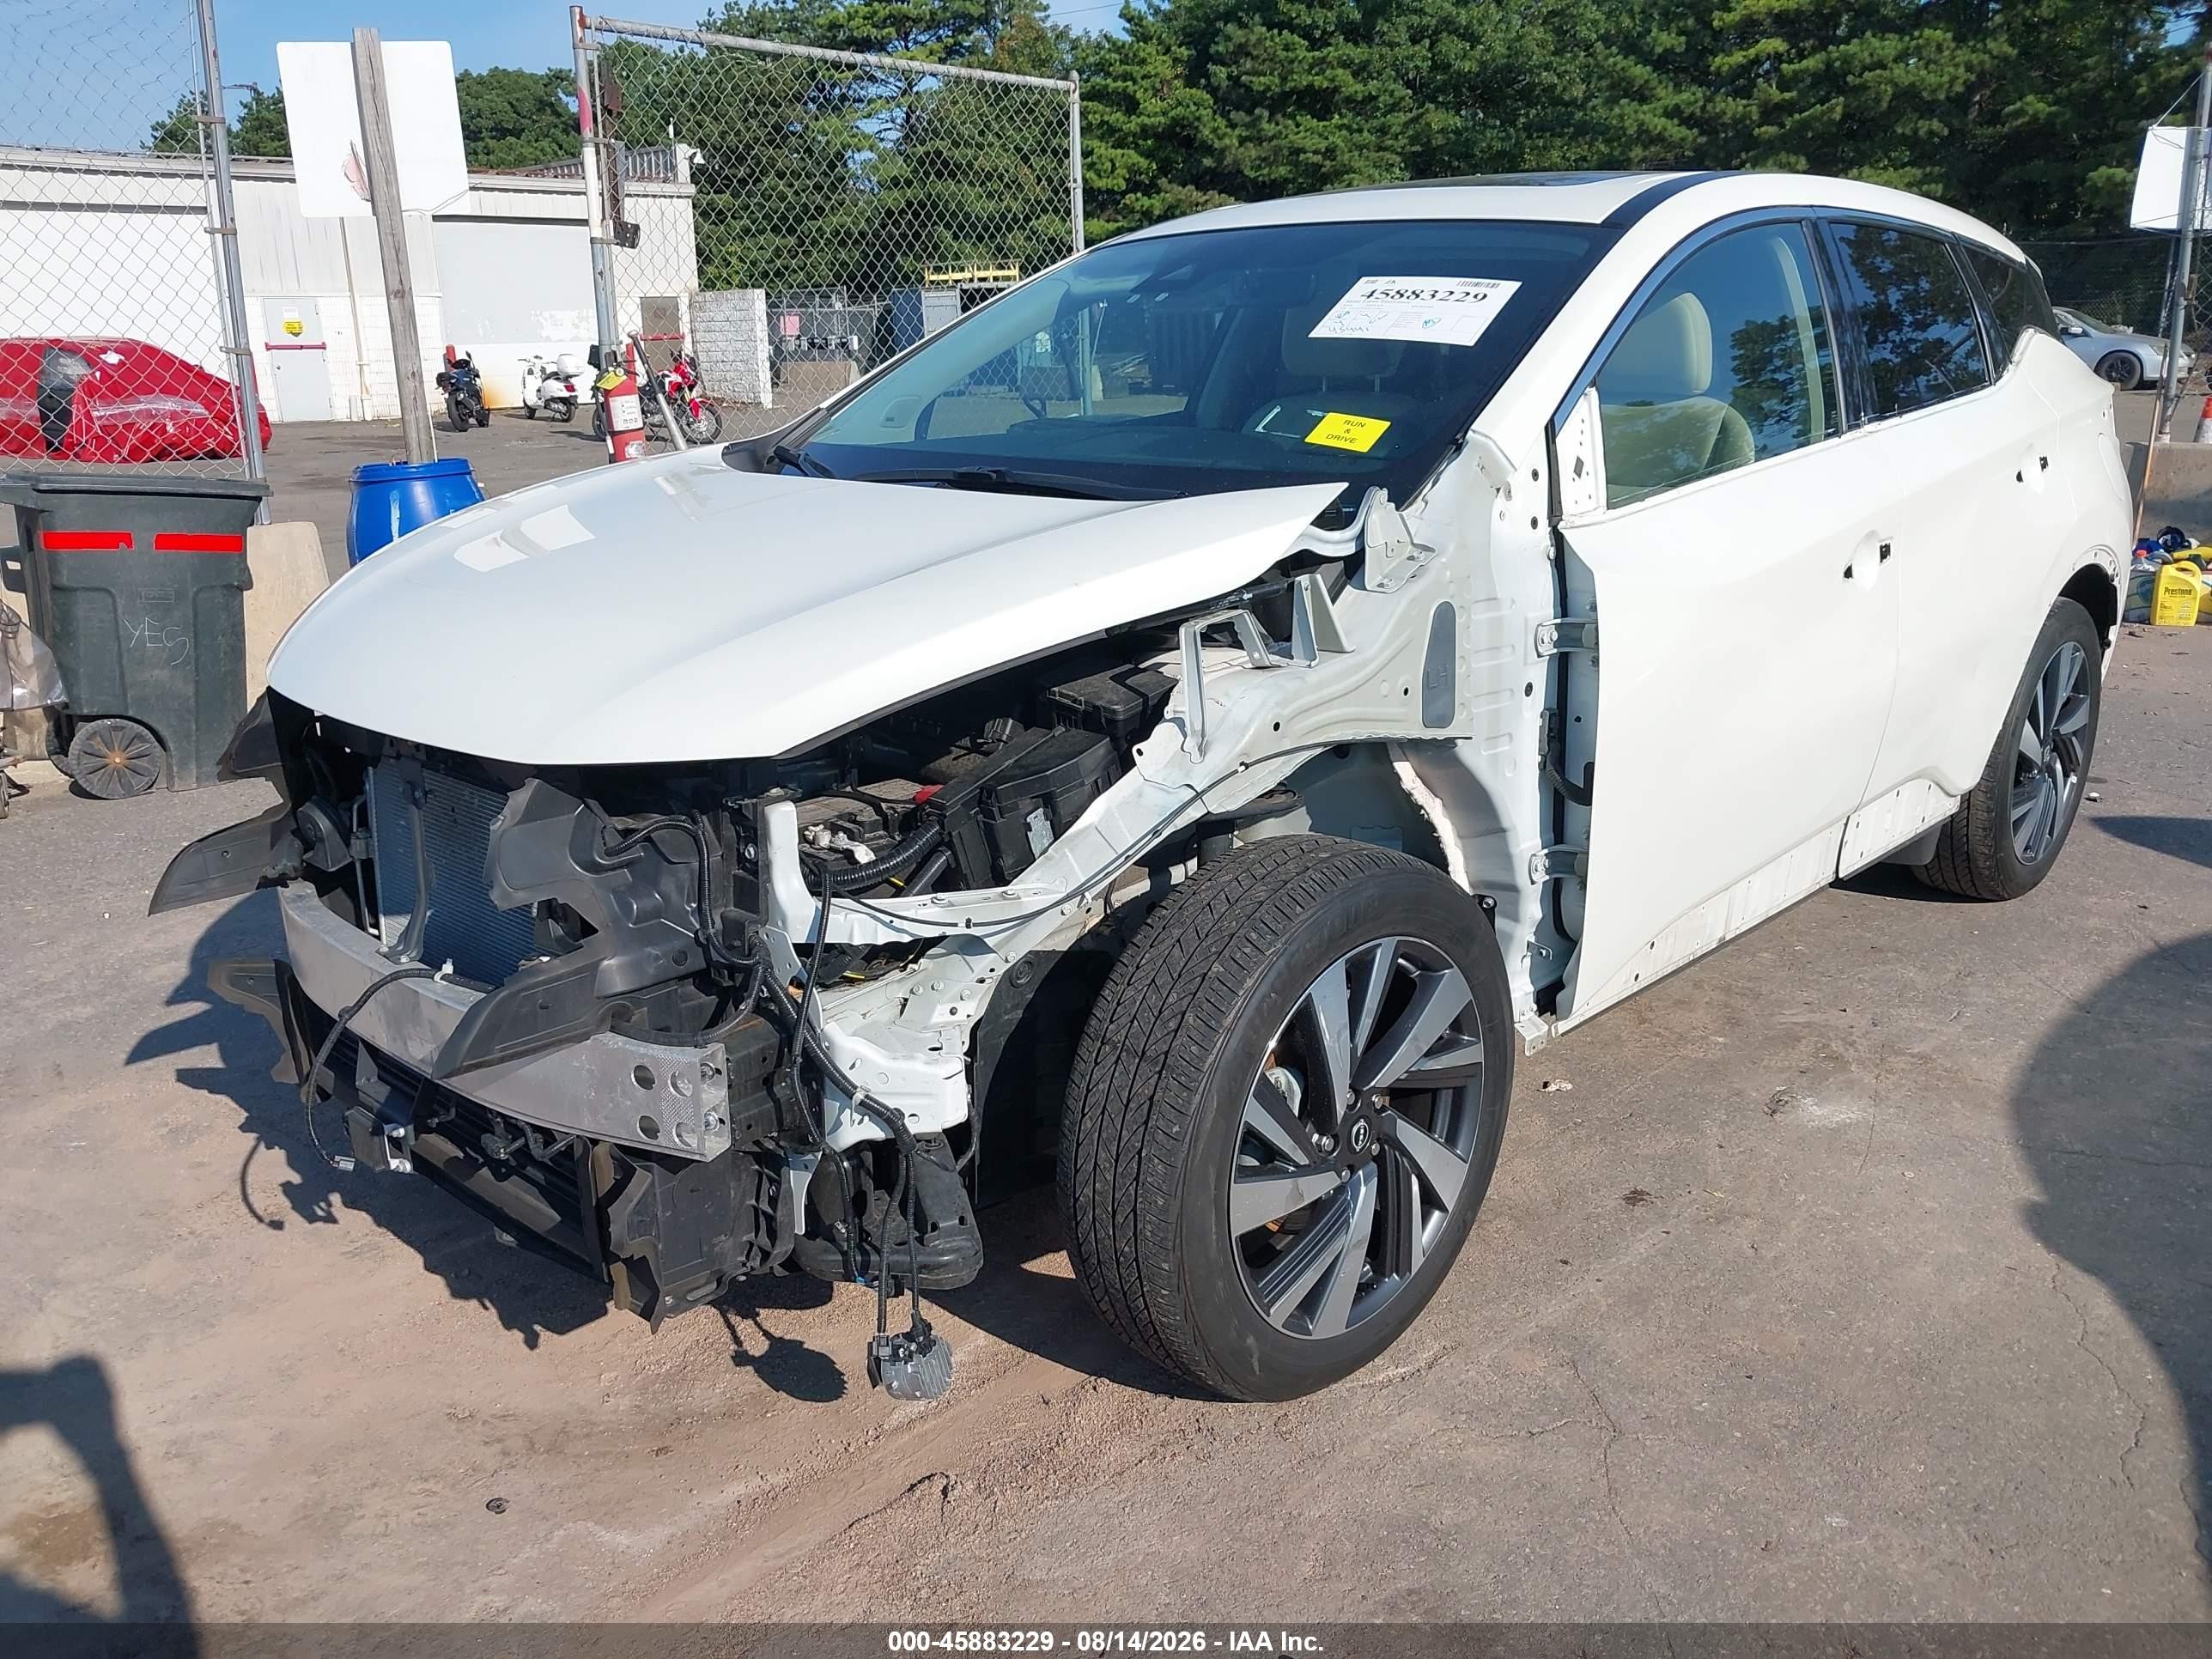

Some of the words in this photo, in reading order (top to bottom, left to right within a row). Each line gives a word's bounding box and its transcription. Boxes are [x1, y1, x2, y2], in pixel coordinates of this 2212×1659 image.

[1360, 289, 1488, 303] 45883229
[1343, 419, 1366, 428] RUN
[1326, 434, 1359, 444] DRIVE
